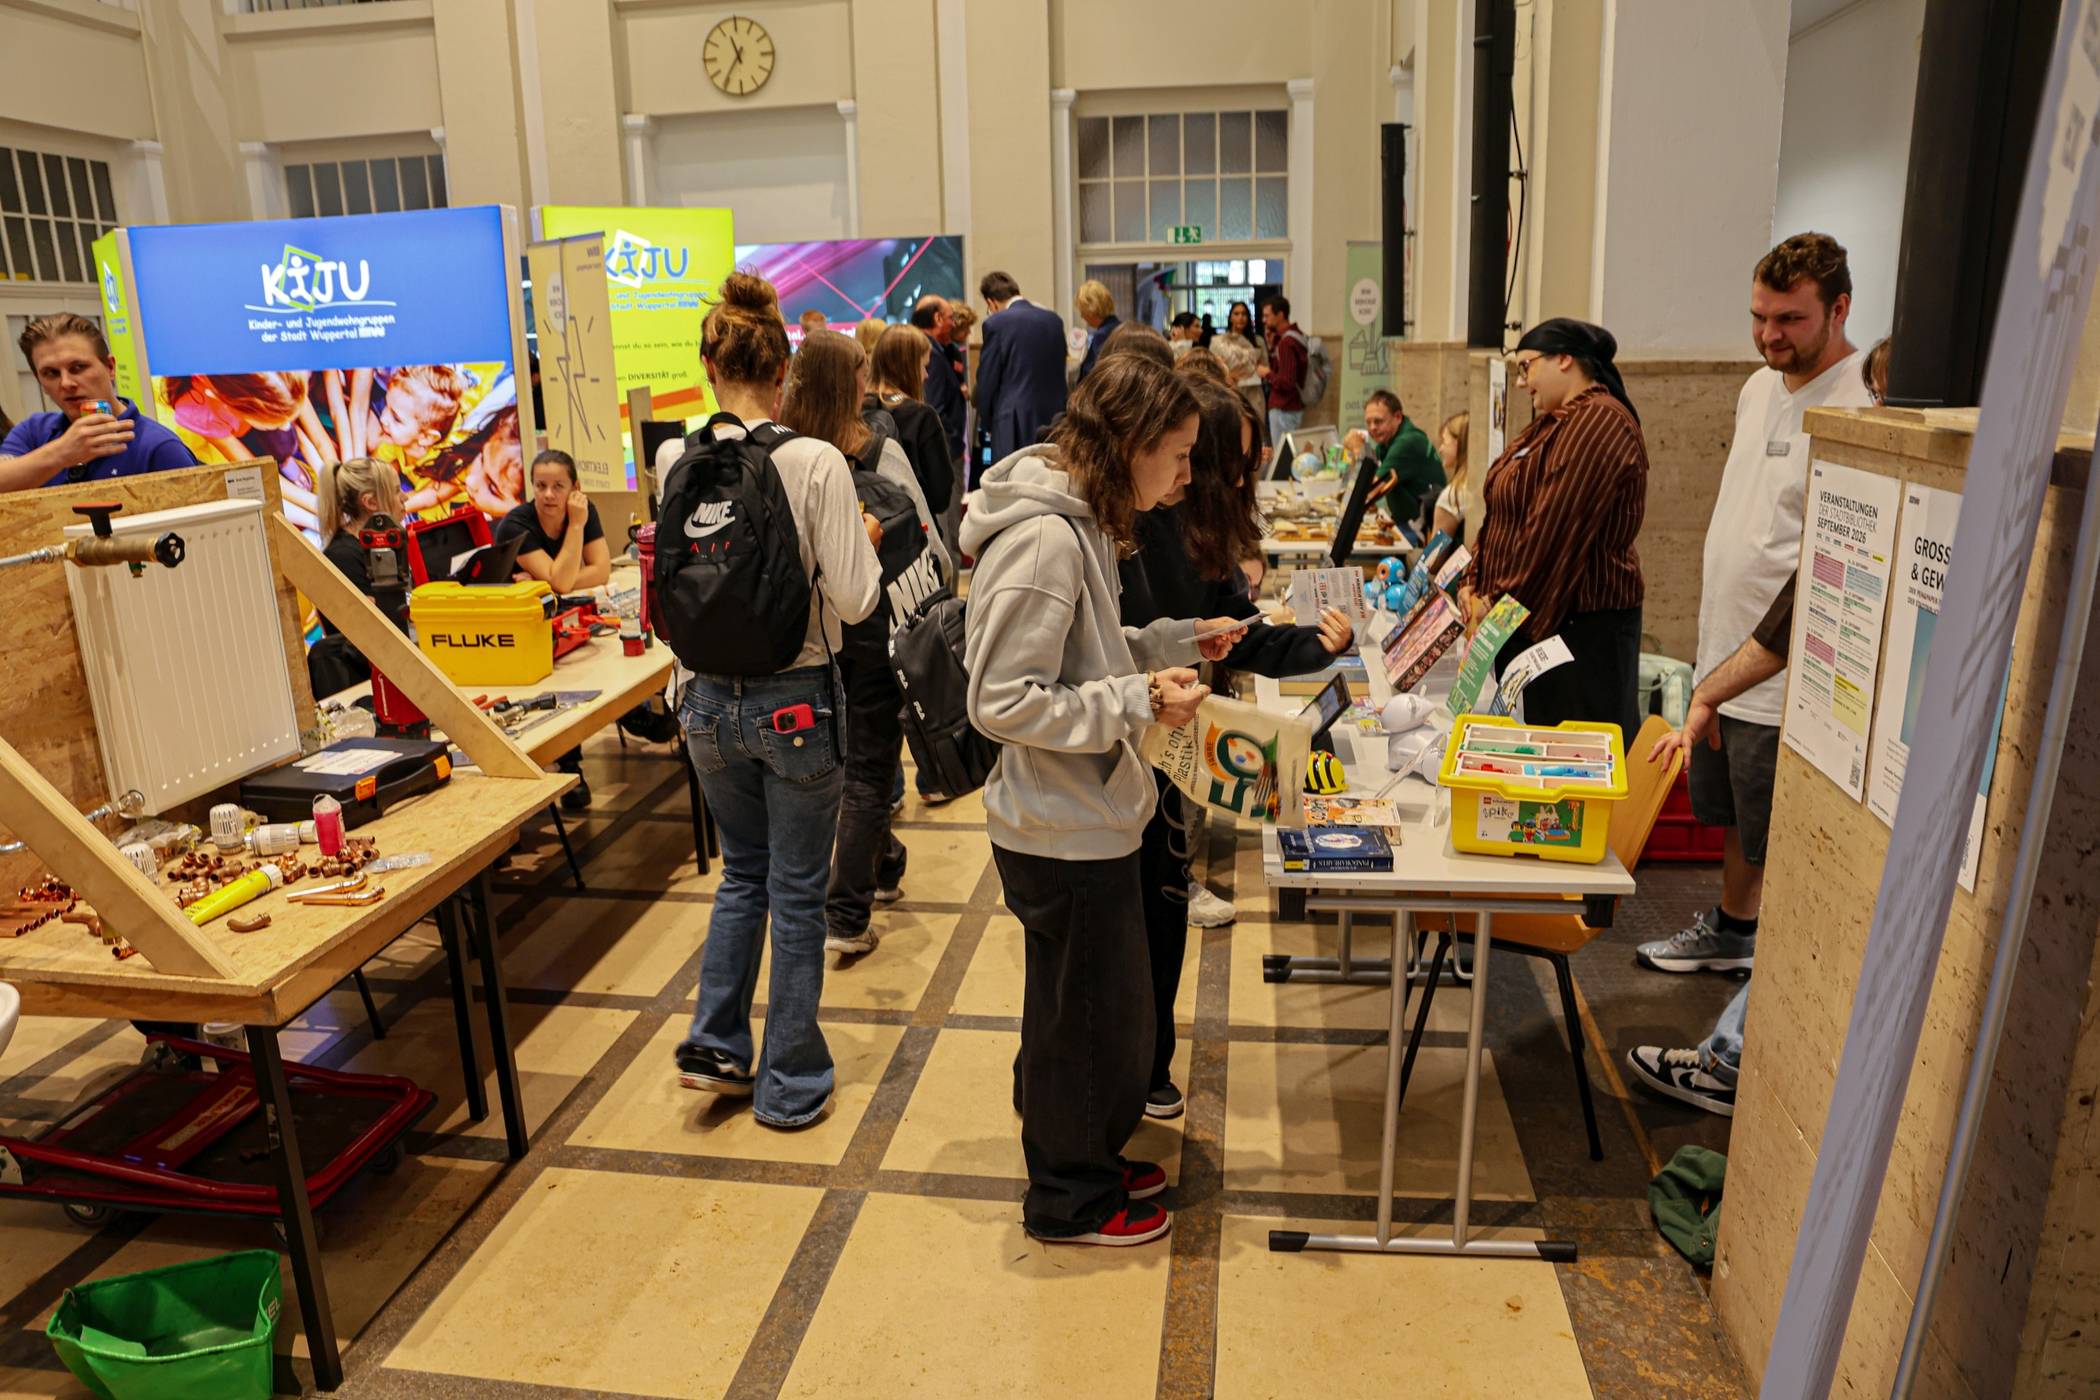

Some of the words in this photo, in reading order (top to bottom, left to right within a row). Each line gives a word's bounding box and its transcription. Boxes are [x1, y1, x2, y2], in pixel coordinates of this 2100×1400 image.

[248, 318, 283, 331] Kinder-
[286, 316, 303, 329] und
[306, 313, 396, 330] Jugendwohngruppen
[261, 331, 278, 343] der
[280, 330, 308, 343] Stadt
[311, 327, 358, 344] Wuppertal
[627, 370, 670, 381] DIVERSITÄT
[692, 500, 733, 524] NIKE
[1819, 490, 1878, 519] VERANSTALTUNGEN
[1817, 516, 1851, 538] SEPTEMBER
[1911, 562, 1919, 582] &
[431, 633, 516, 648] FLUKE
